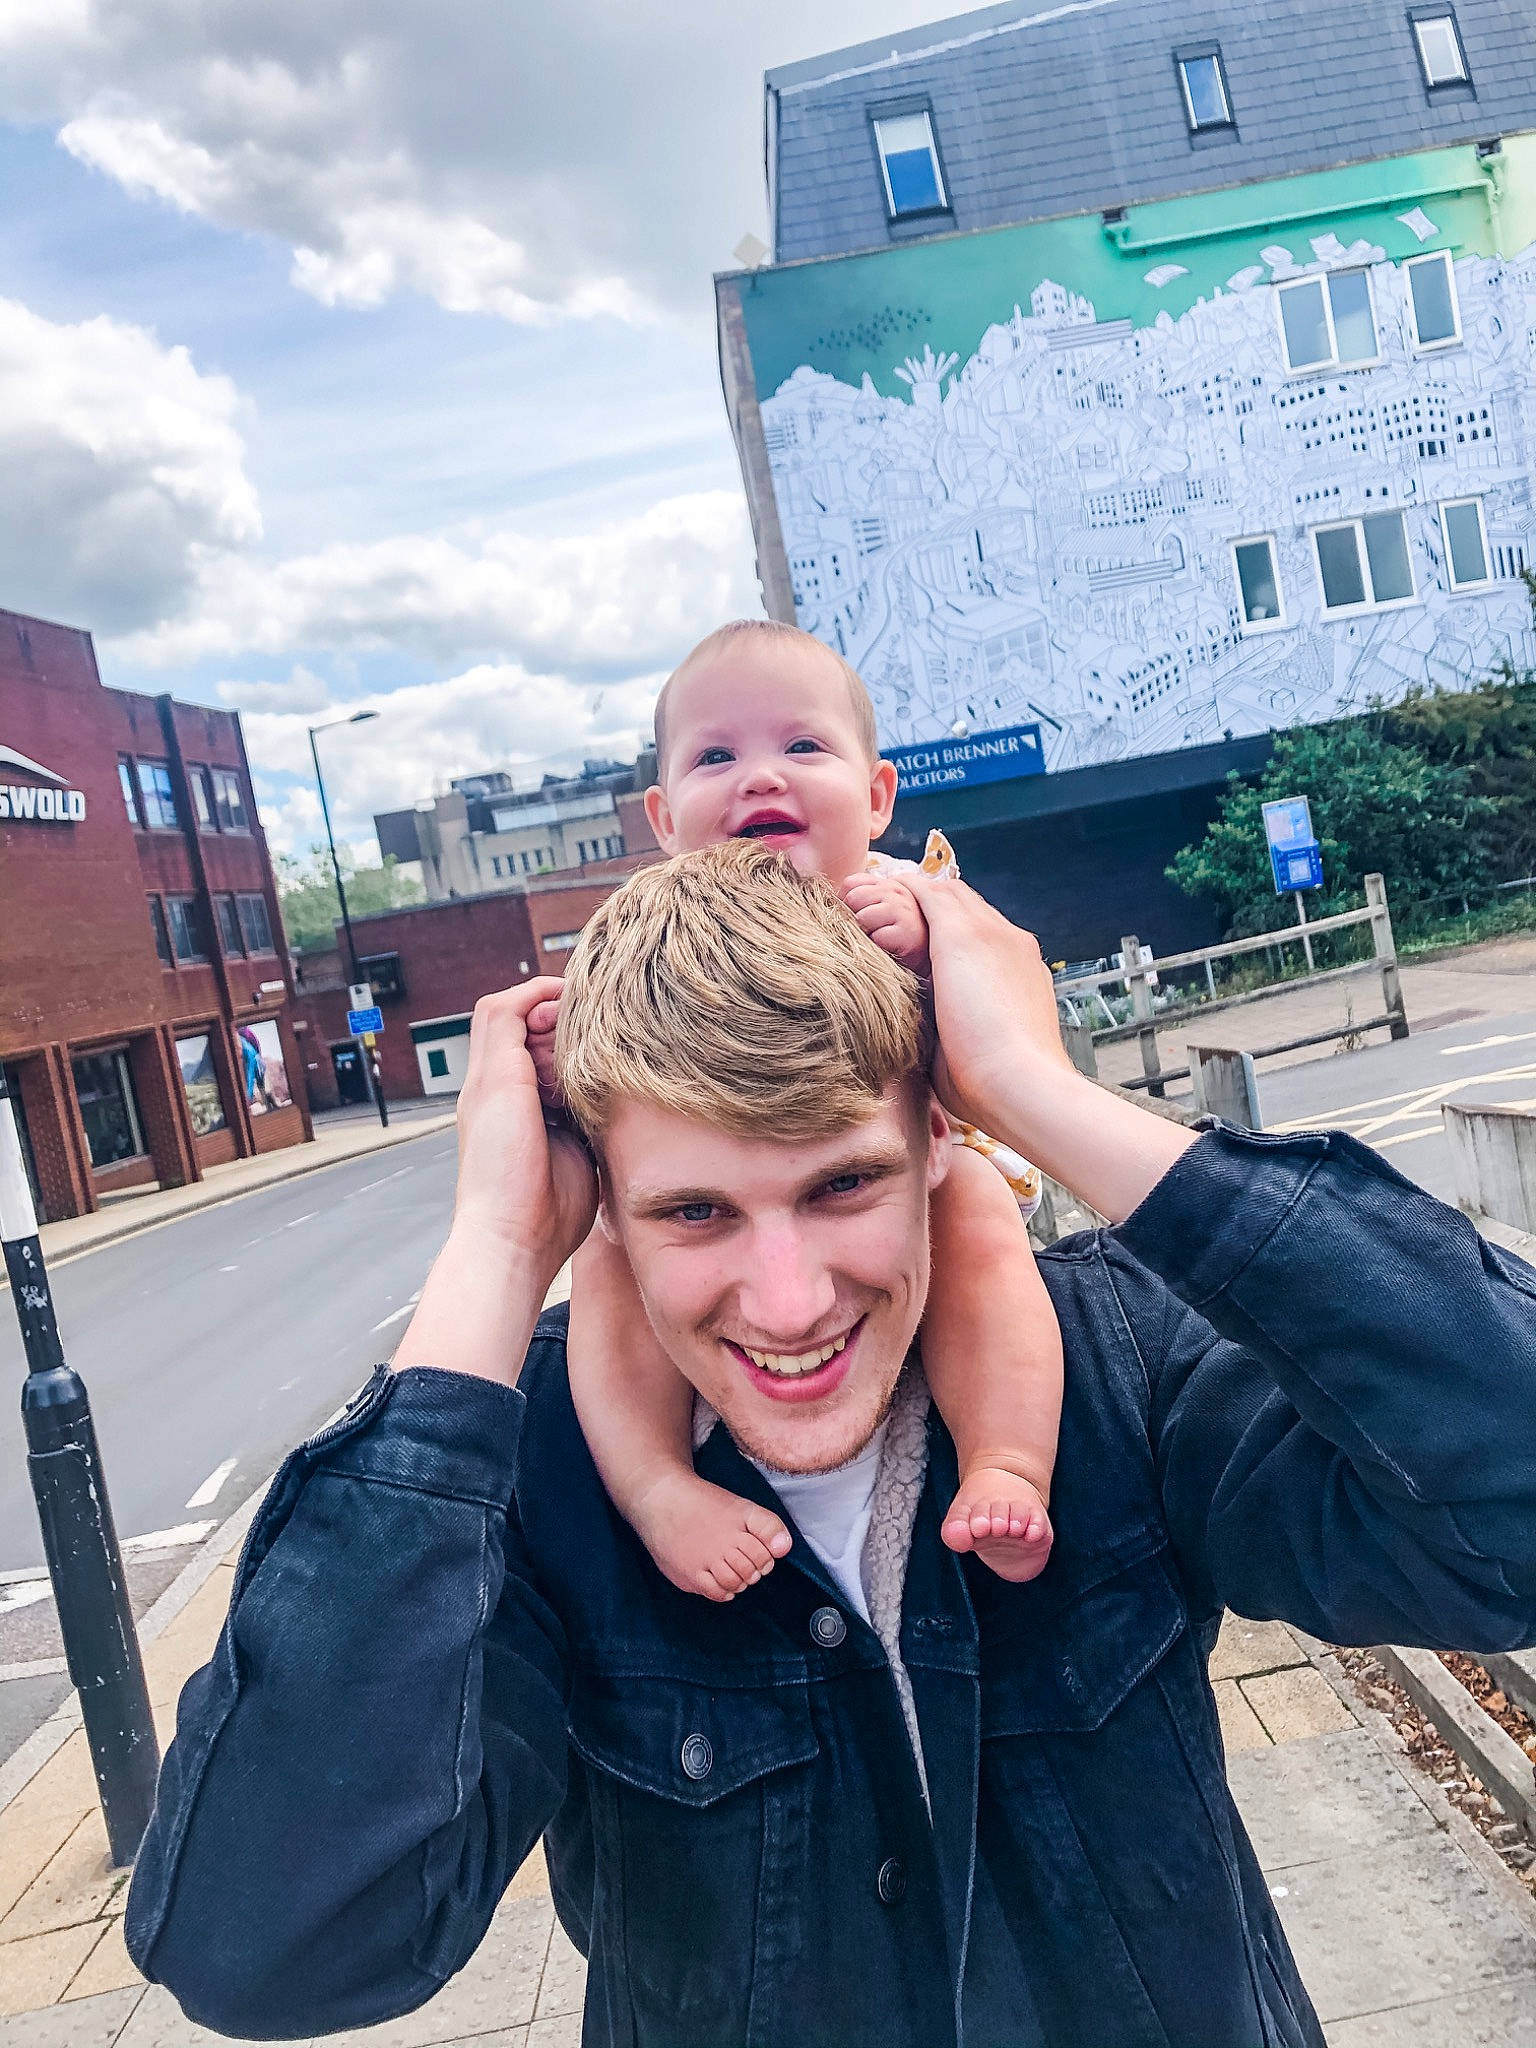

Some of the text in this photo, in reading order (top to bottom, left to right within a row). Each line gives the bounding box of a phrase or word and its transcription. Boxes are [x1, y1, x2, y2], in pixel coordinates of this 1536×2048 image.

[892, 736, 1019, 771] ATCH BRENNER
[897, 765, 966, 790] OLICITORS
